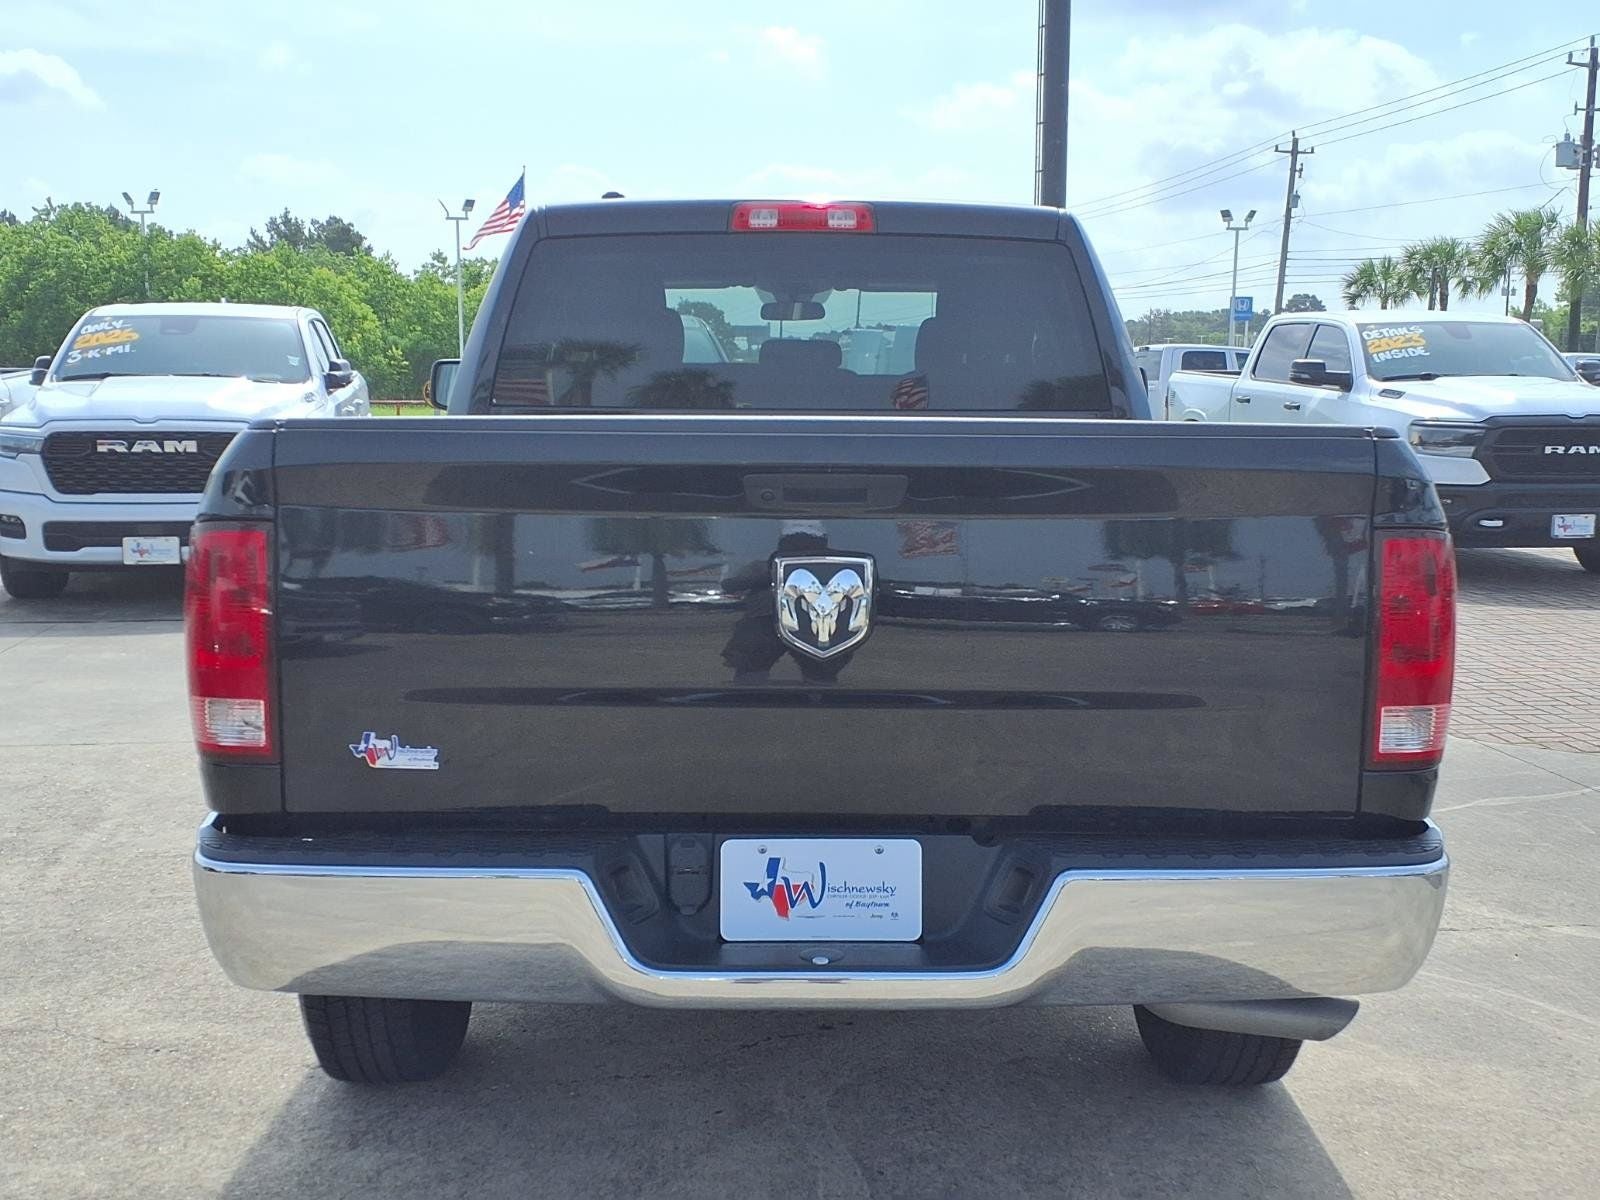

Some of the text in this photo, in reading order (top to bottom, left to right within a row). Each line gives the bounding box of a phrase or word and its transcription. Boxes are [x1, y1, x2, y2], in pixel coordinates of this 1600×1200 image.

[1361, 325, 1424, 340] DETAILS
[1372, 346, 1431, 363] INSIDE
[96, 439, 198, 453] RAM
